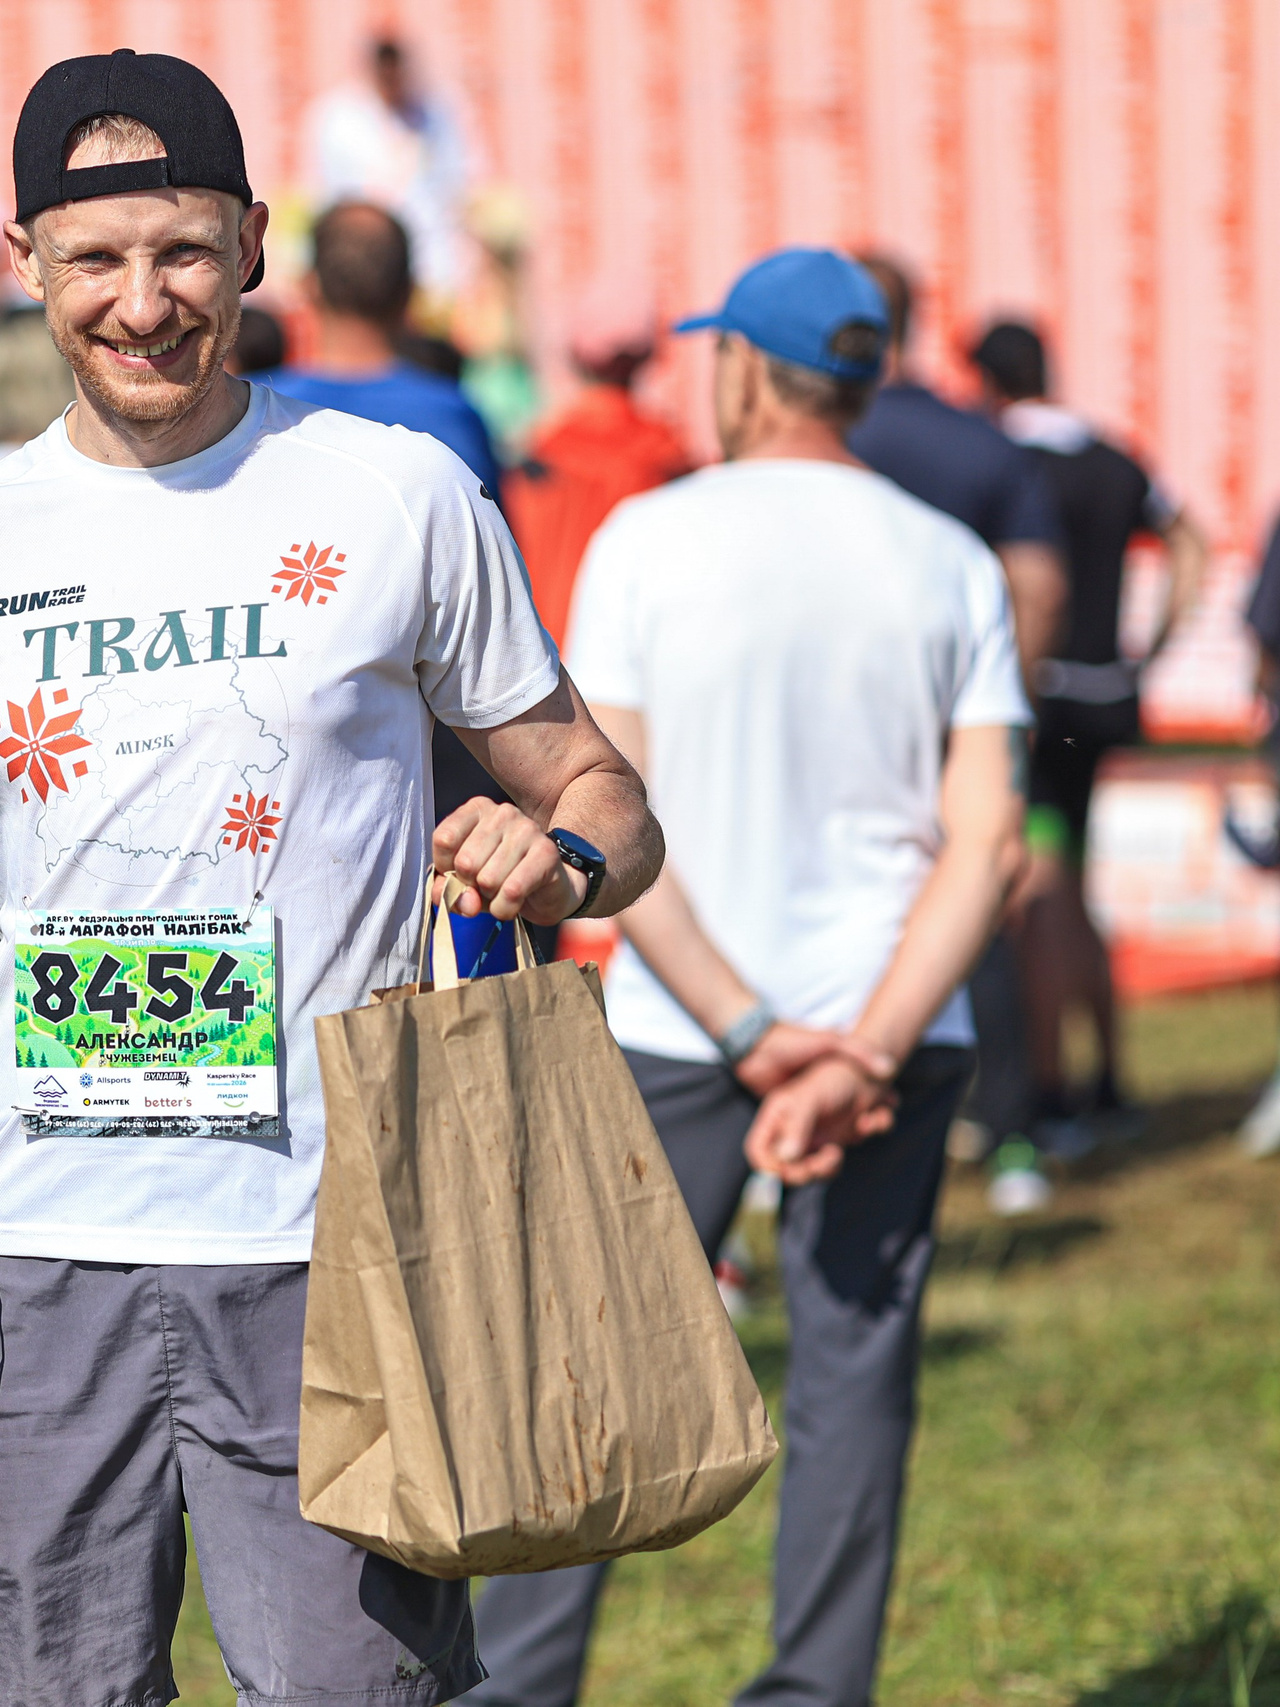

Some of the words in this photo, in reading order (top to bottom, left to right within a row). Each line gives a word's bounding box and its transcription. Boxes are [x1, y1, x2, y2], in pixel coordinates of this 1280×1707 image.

[52, 585, 87, 597] TRAIL
[48, 594, 86, 607] RACE
[23, 602, 288, 683] TRAIL
[115, 733, 174, 755] MINSK
[46, 915, 74, 923] ARF.BY
[78, 915, 134, 924] ФЕДЭРАЦЫЯ
[209, 913, 238, 921] ГОНАК
[39, 922, 66, 937] 18-й
[69, 923, 154, 937] МАРАФОН
[30, 951, 256, 1024] 8454
[75, 1032, 209, 1052] АЛЕКСАНДР
[105, 1053, 177, 1063] ЧУЖЕЗЕМЕЦ
[144, 1096, 192, 1108] better's
